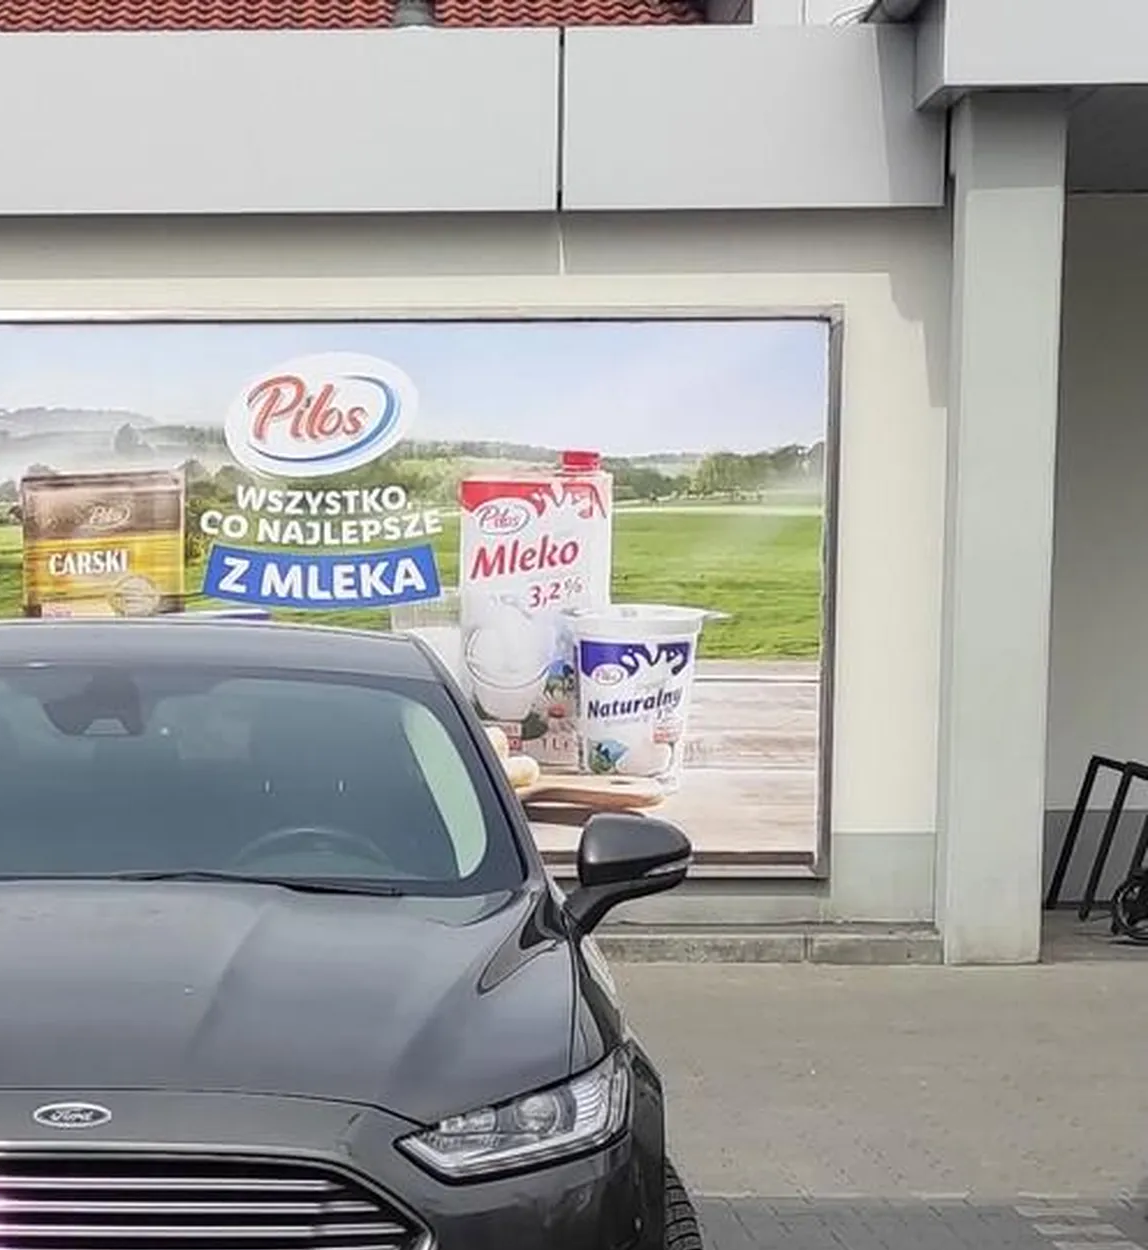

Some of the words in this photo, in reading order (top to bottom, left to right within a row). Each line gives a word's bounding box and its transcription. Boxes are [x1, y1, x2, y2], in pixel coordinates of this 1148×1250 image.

[247, 375, 369, 441] Pilos
[200, 510, 249, 539] CO
[256, 509, 443, 546] NAJLEPSZE
[48, 548, 129, 577] CARSKI
[469, 534, 580, 581] Mleko
[218, 556, 251, 594] Z
[260, 557, 428, 600] MLEKA
[588, 687, 682, 720] Naturalny
[50, 1109, 94, 1122] Ford
